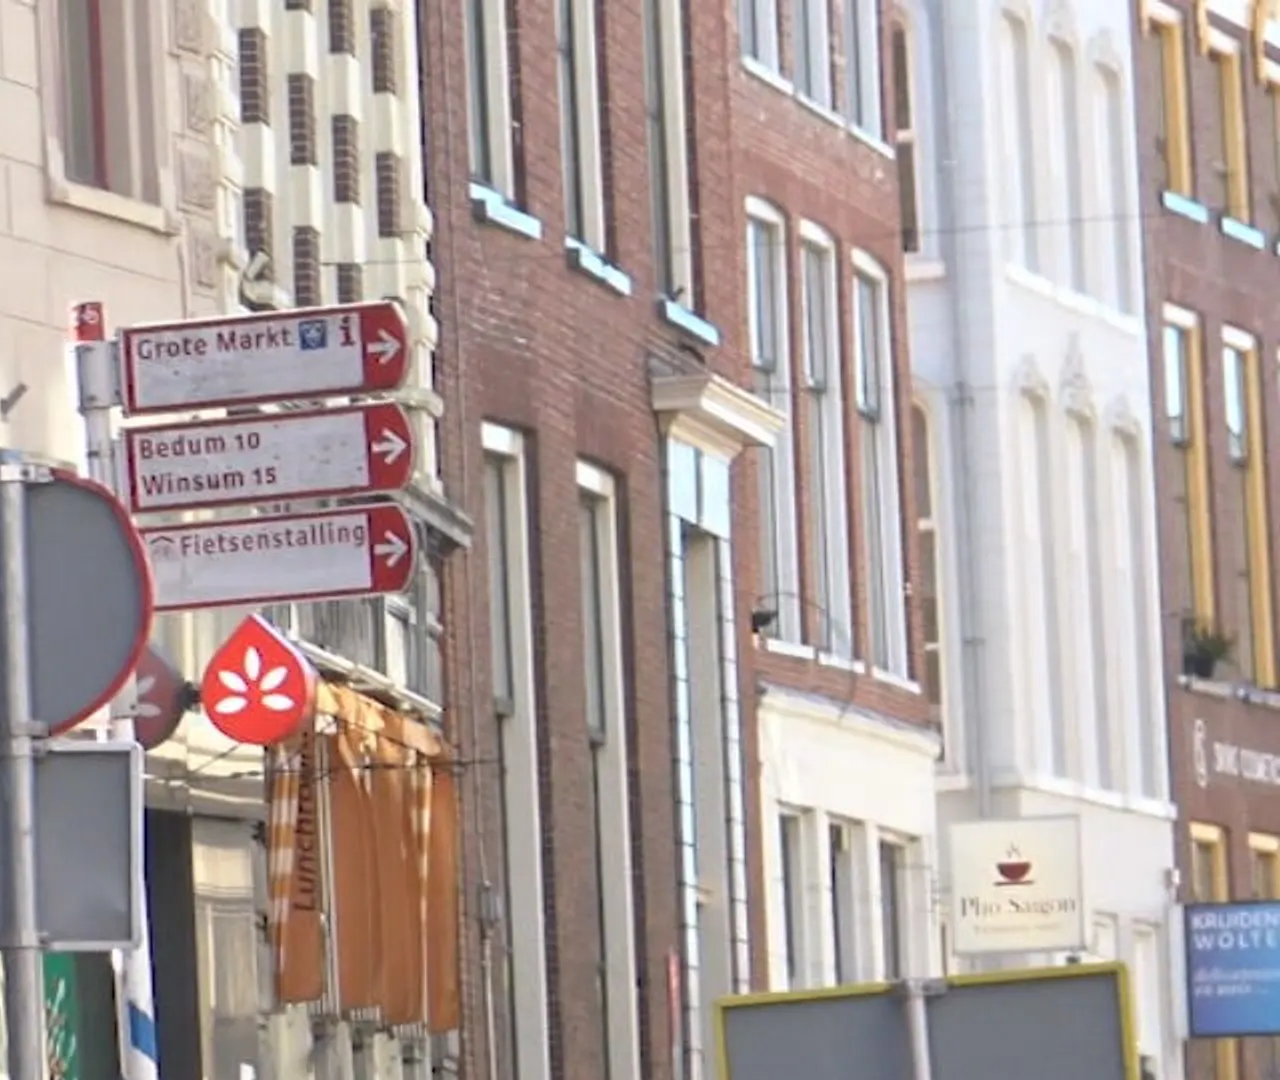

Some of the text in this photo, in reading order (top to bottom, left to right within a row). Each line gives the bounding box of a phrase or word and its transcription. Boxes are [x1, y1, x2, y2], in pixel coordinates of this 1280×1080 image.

[137, 333, 207, 360] Grote
[216, 327, 293, 351] Markt
[140, 431, 260, 460] Bedum 10
[142, 466, 277, 496] Winsum 15
[181, 522, 366, 556] Fietsenstalling
